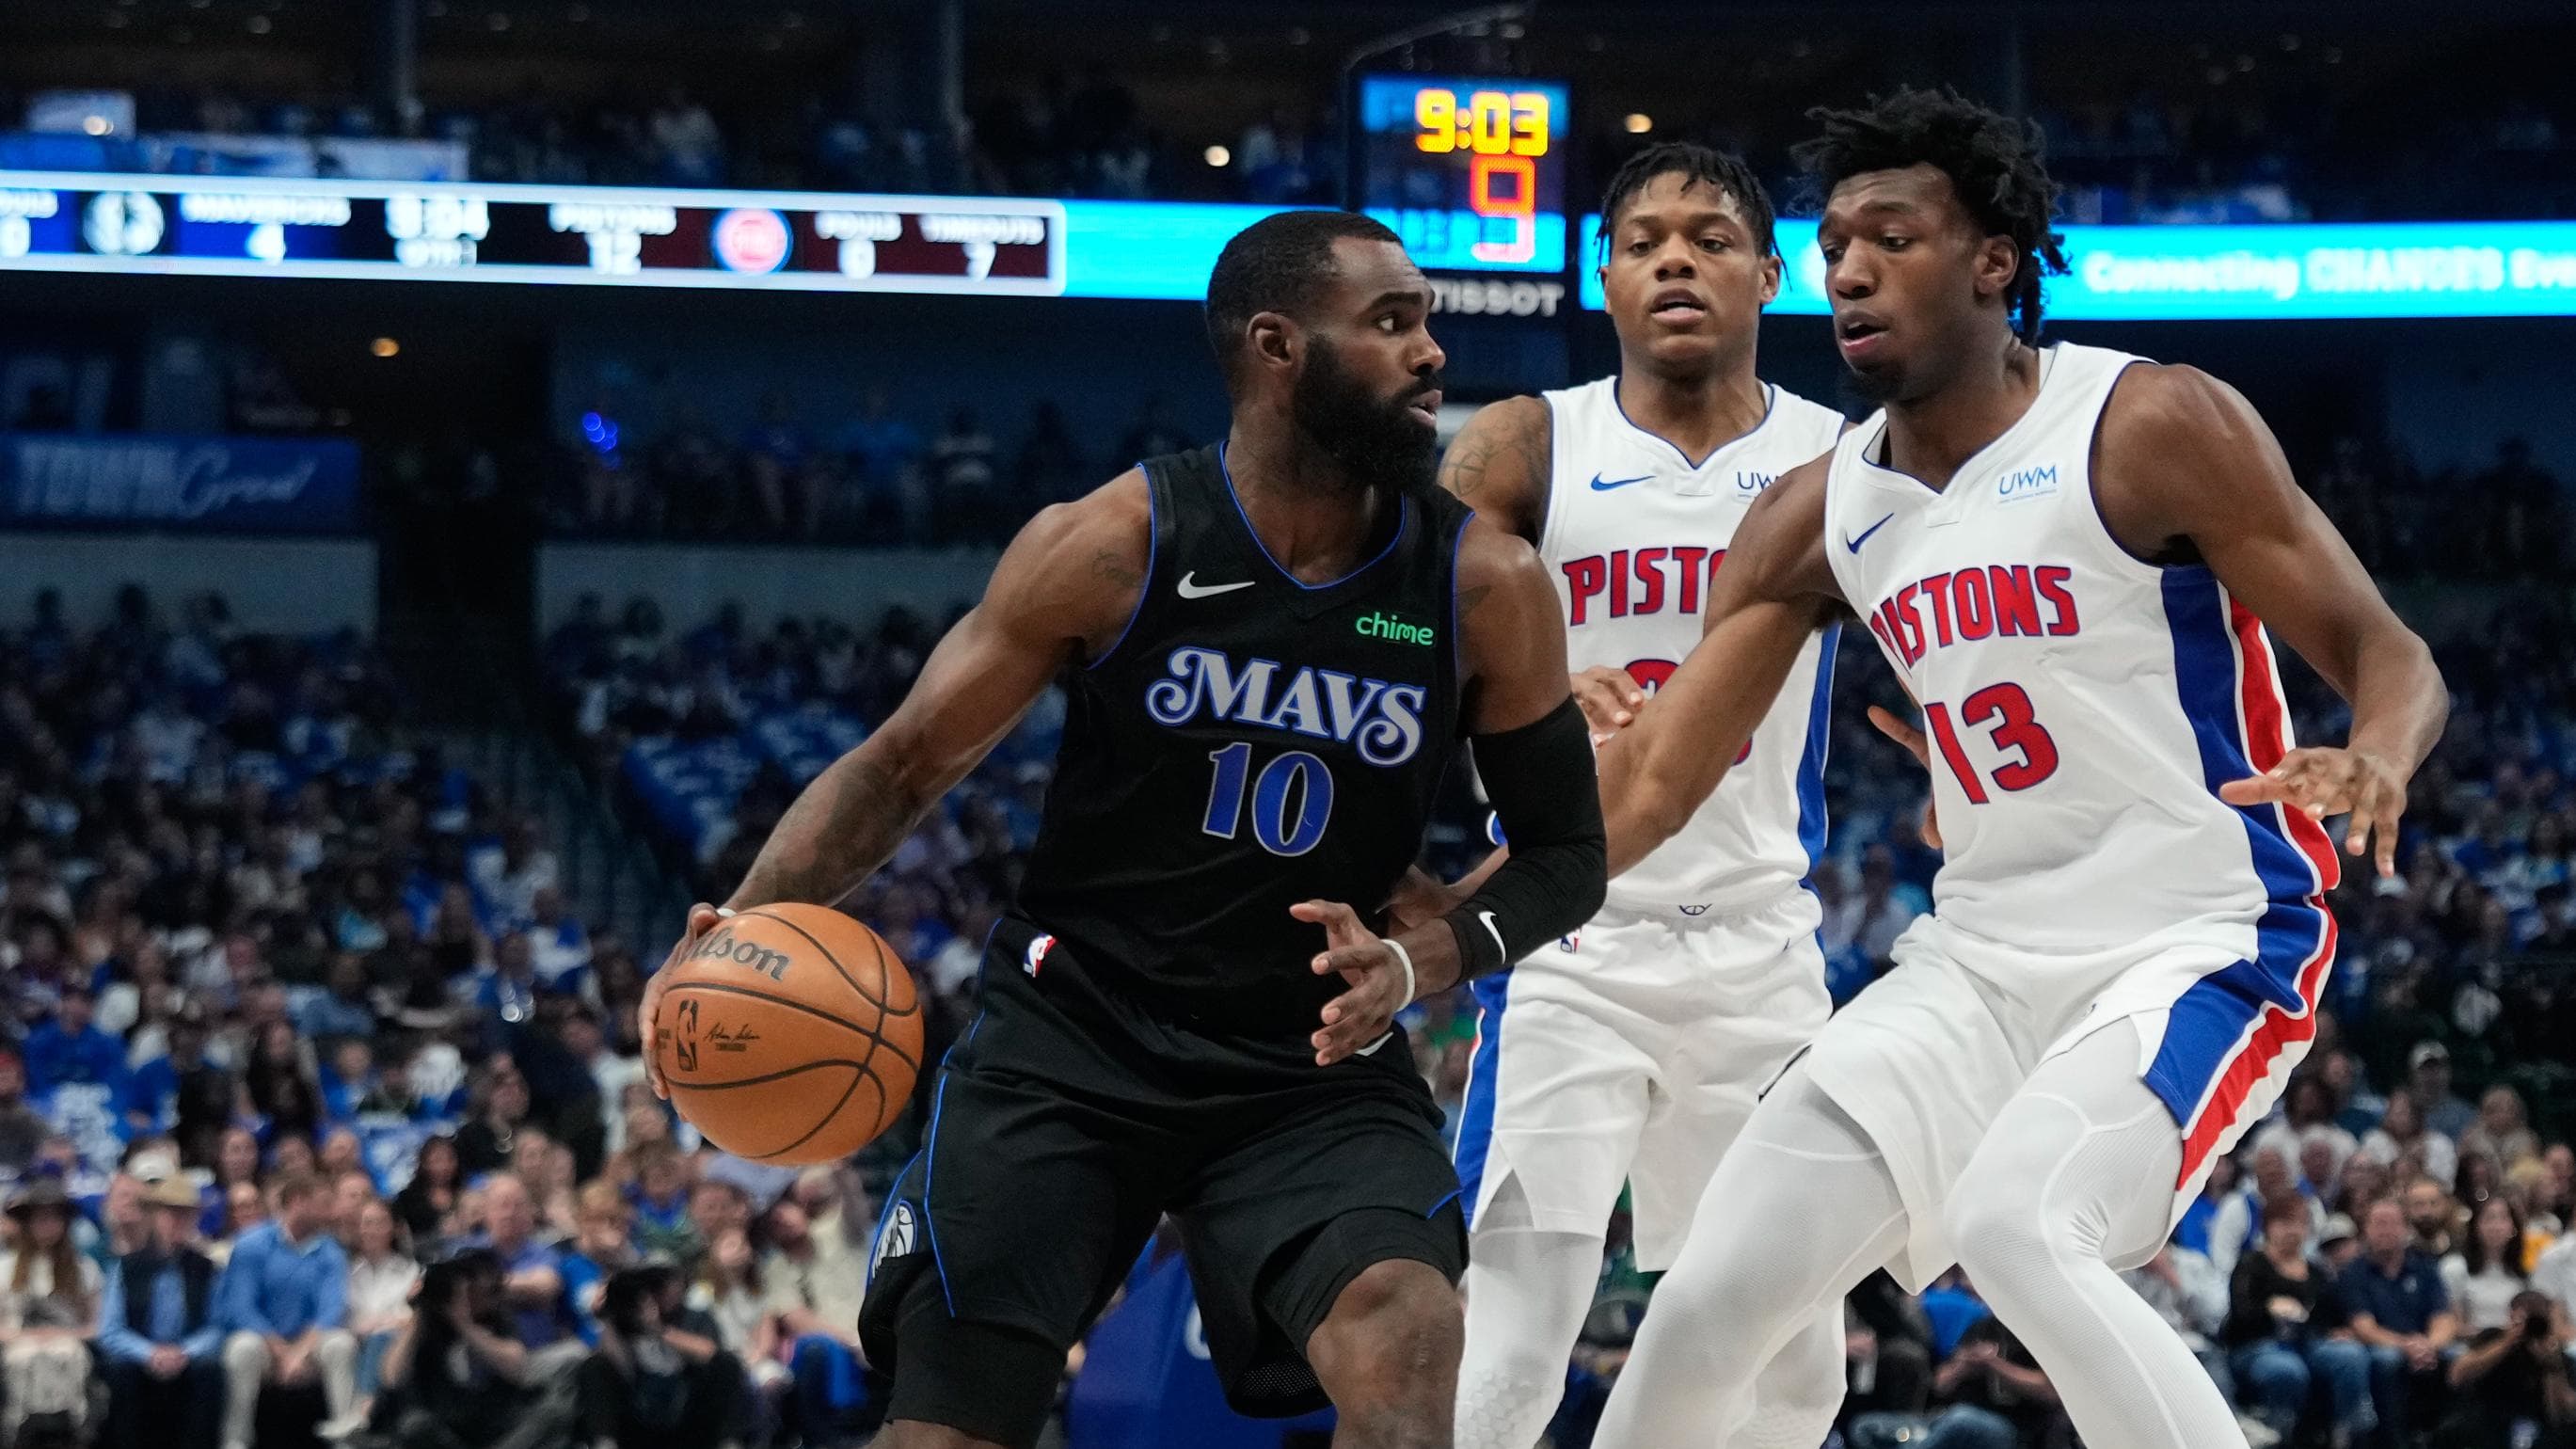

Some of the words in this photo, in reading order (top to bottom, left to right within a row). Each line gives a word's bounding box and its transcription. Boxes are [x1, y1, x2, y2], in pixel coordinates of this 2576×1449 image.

[1415, 89, 1549, 156] 9:03
[1471, 154, 1535, 263] 9
[966, 241, 995, 282] 7
[2084, 249, 2300, 301] Connecting
[2305, 247, 2505, 294] CHANGES
[1737, 471, 1781, 490] UW
[1999, 464, 2058, 495] UWM
[1356, 612, 1434, 646] chime
[1869, 565, 2080, 678] PISTONS
[1145, 645, 1426, 768] MAVS
[1924, 681, 2059, 804] 13
[1202, 741, 1334, 857] 10
